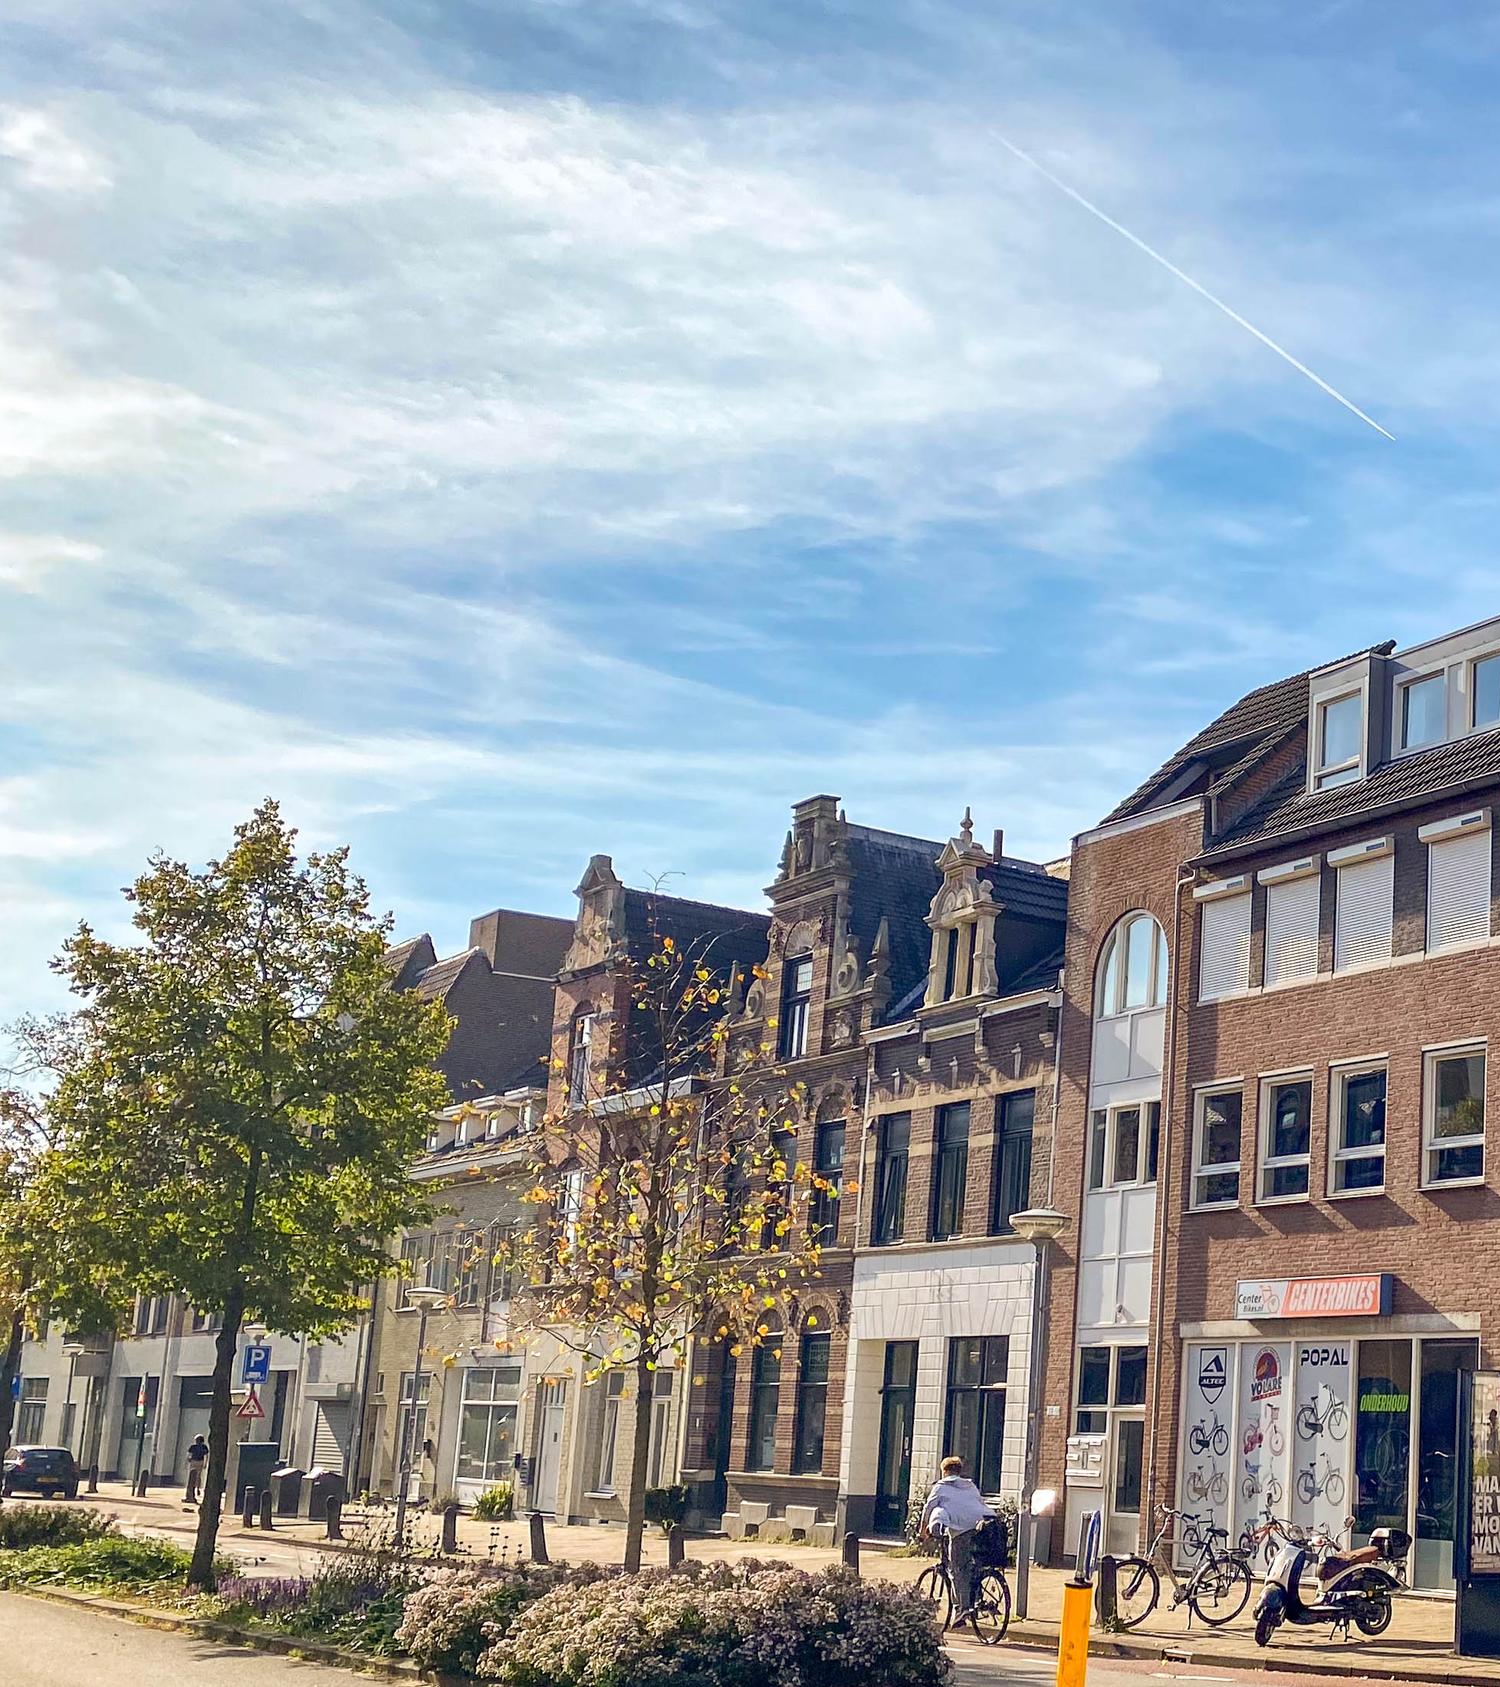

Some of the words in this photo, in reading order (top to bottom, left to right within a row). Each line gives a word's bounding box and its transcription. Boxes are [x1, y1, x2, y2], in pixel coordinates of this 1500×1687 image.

[1238, 1294, 1262, 1304] Center
[1288, 1281, 1376, 1311] CENTERBIKES
[250, 1348, 265, 1368] P
[1301, 1348, 1348, 1366] POPAL
[1251, 1376, 1282, 1396] VOLARE
[1360, 1394, 1408, 1412] ONDERHOUD
[1475, 1496, 1493, 1513] ER
